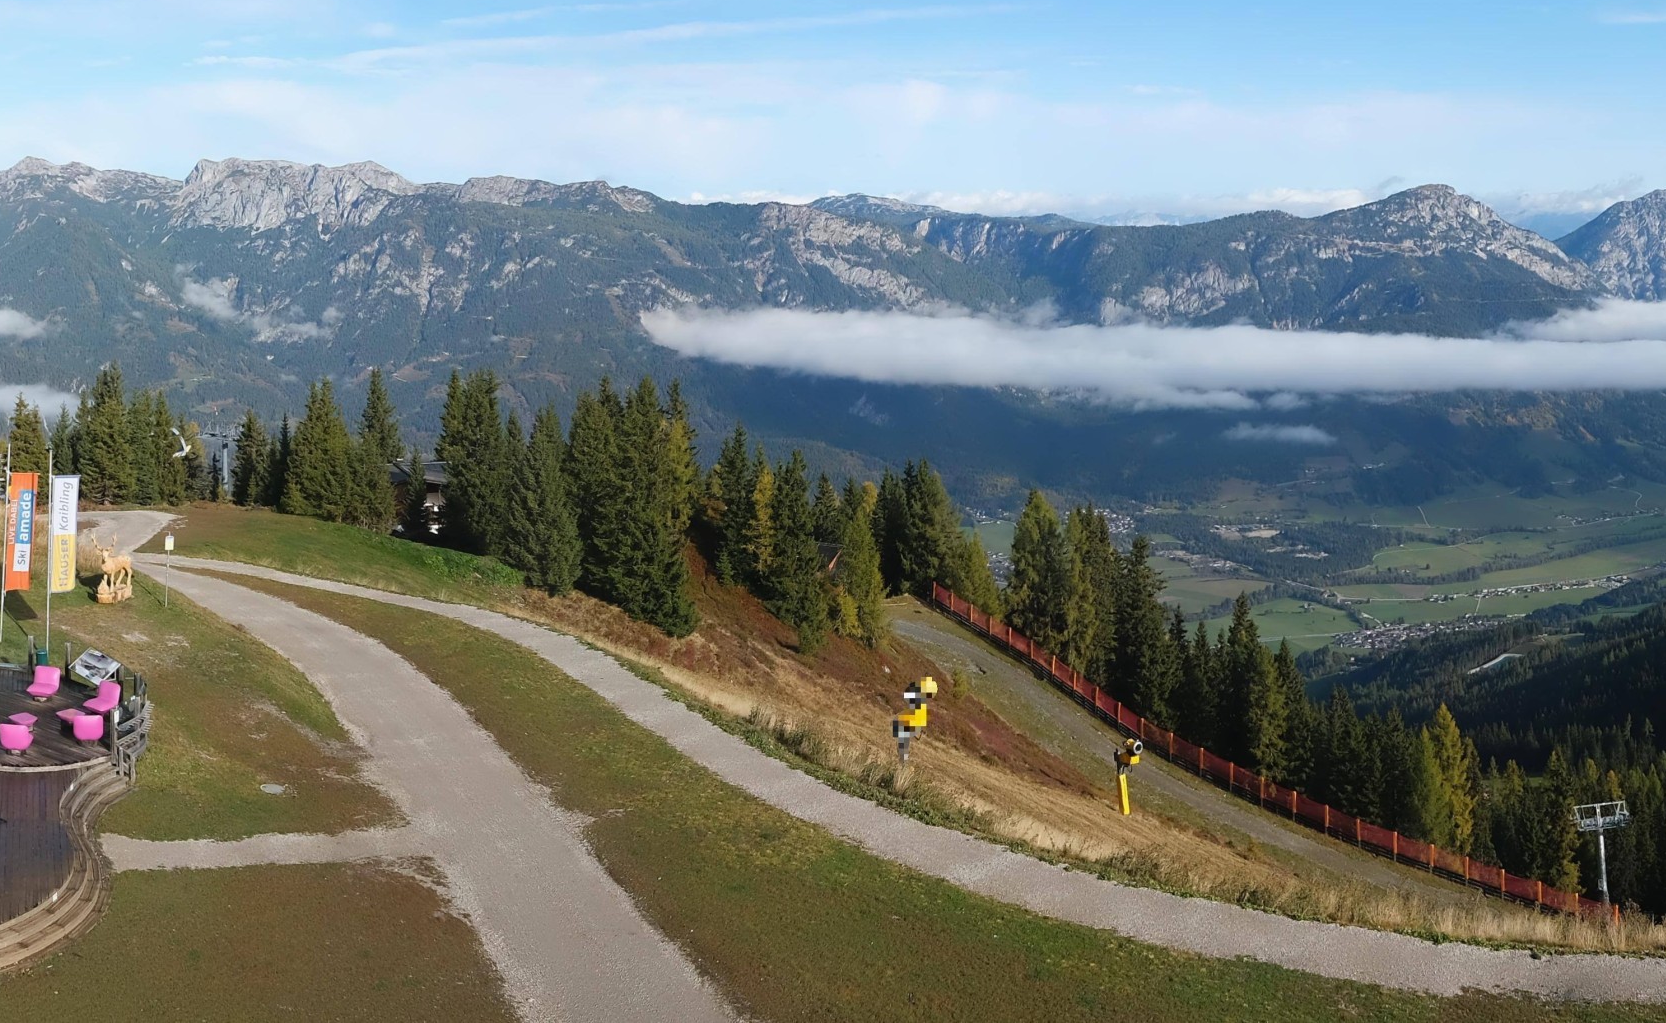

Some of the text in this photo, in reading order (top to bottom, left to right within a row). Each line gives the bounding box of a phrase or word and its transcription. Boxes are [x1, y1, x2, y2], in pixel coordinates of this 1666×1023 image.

[8, 499, 19, 545] LIVE DABEI
[59, 481, 74, 531] Kaibling
[17, 550, 28, 565] Ski
